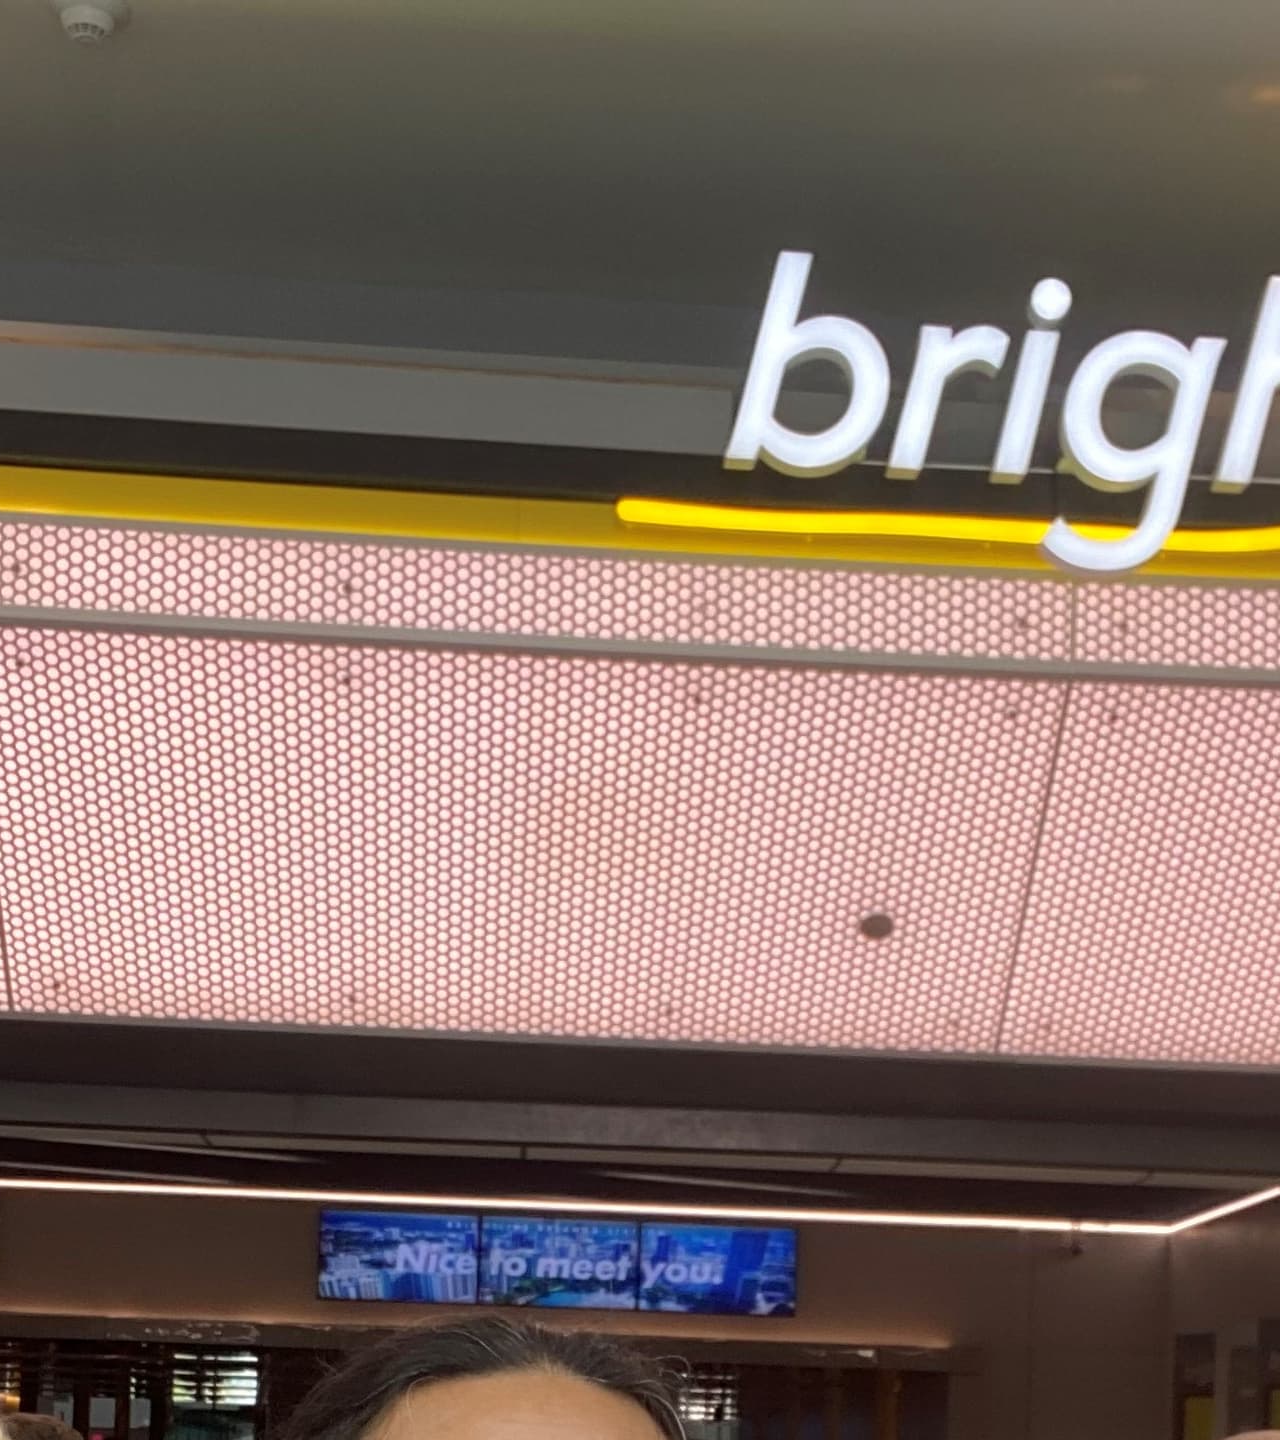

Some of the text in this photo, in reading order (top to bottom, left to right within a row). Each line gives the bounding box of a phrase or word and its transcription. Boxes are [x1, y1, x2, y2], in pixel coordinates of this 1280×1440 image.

[393, 1243, 725, 1288] Nice to meet you.
